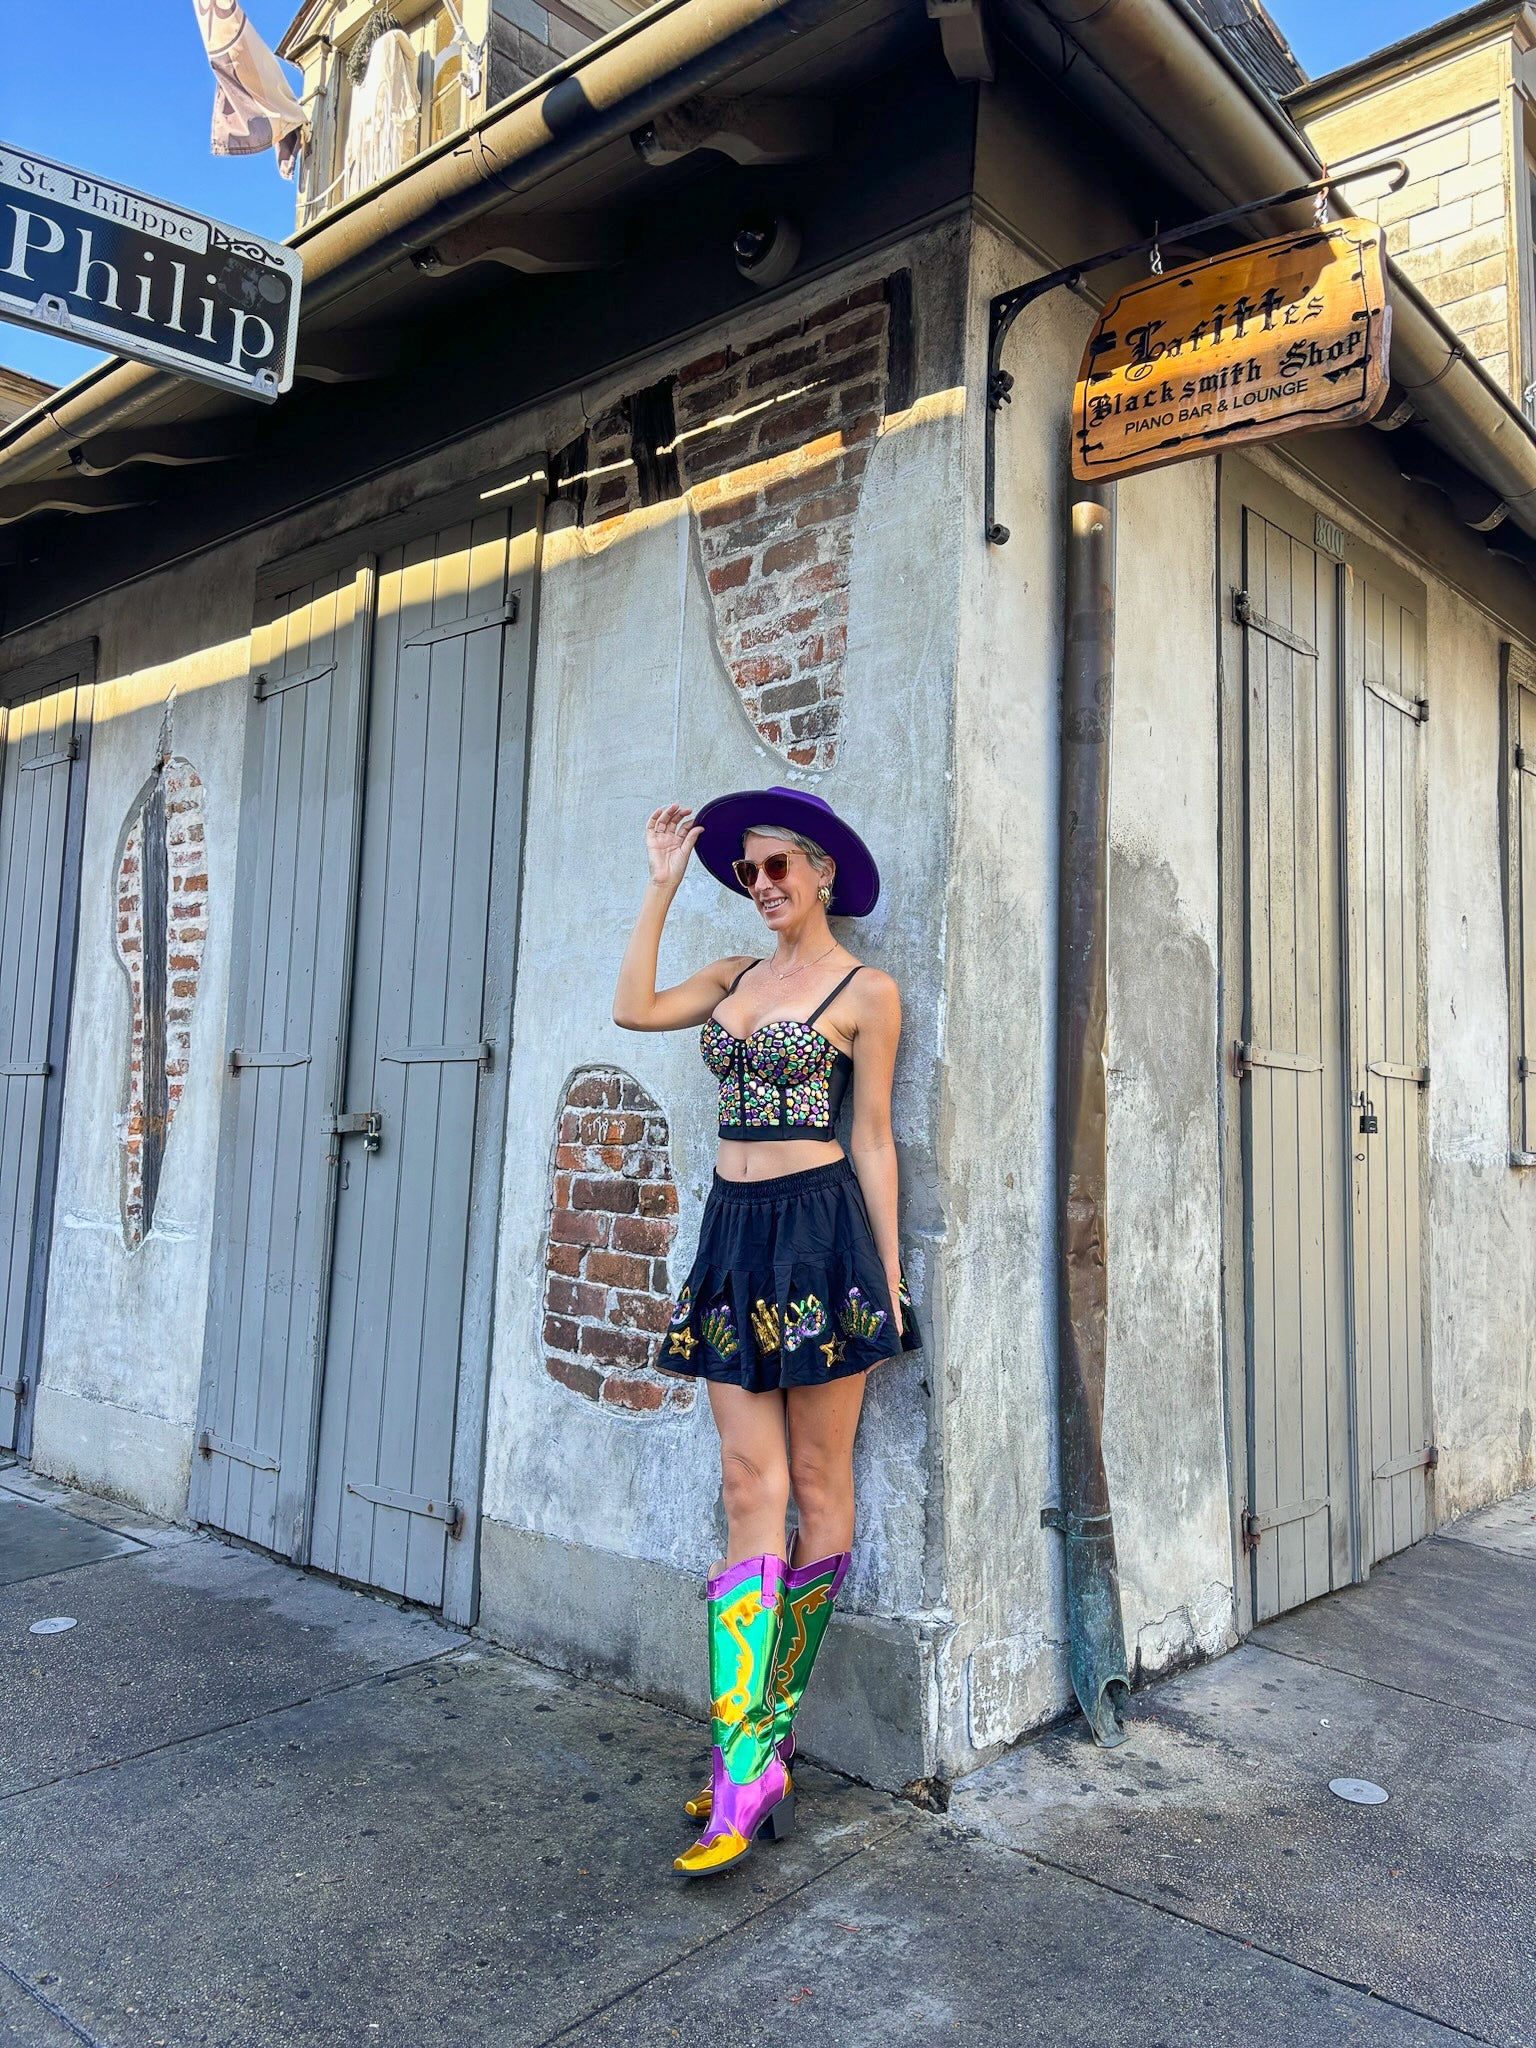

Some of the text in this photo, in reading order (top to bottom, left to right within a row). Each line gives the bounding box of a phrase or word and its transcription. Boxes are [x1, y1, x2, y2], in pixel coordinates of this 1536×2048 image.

[18, 161, 193, 243] St. Philippe
[0, 204, 275, 371] Philip
[1088, 331, 1363, 428] Blacksmith Shop
[1124, 378, 1309, 435] PIANO BAR & LOUNGE
